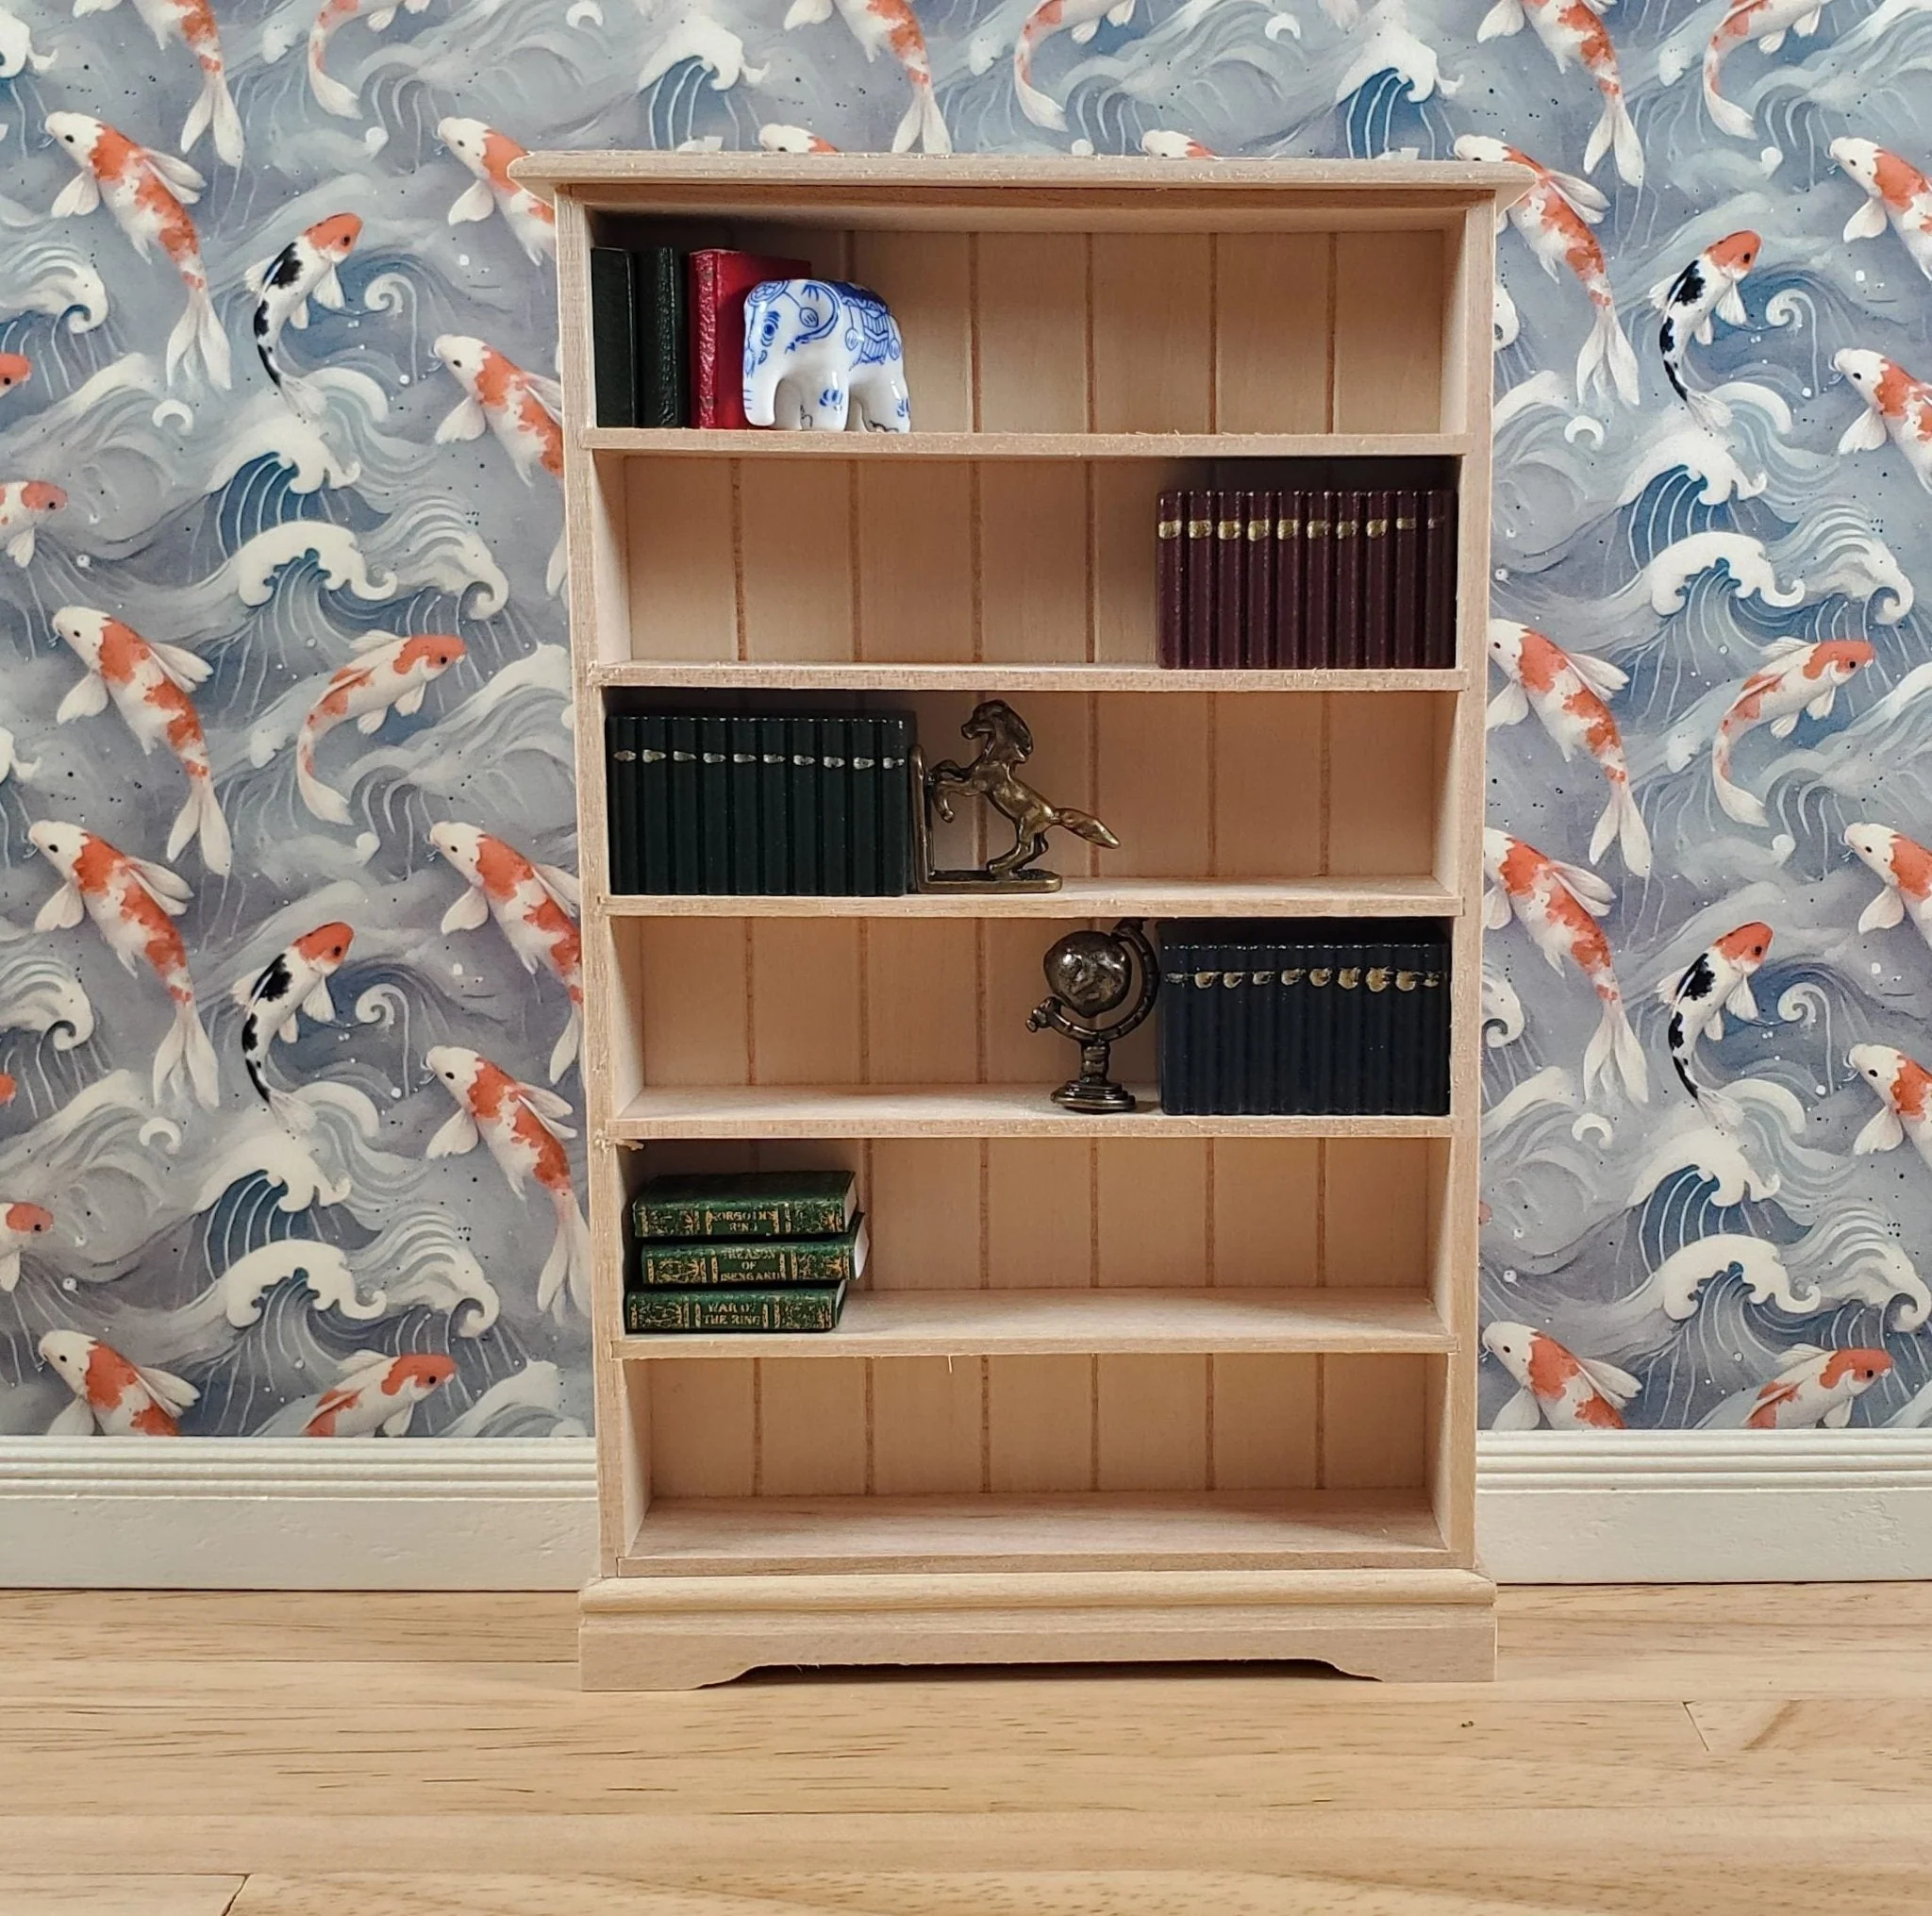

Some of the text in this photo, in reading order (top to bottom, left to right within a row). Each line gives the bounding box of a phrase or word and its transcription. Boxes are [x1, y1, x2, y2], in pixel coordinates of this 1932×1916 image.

[741, 1260, 757, 1270] OF
[704, 1314, 760, 1325] THE RING
